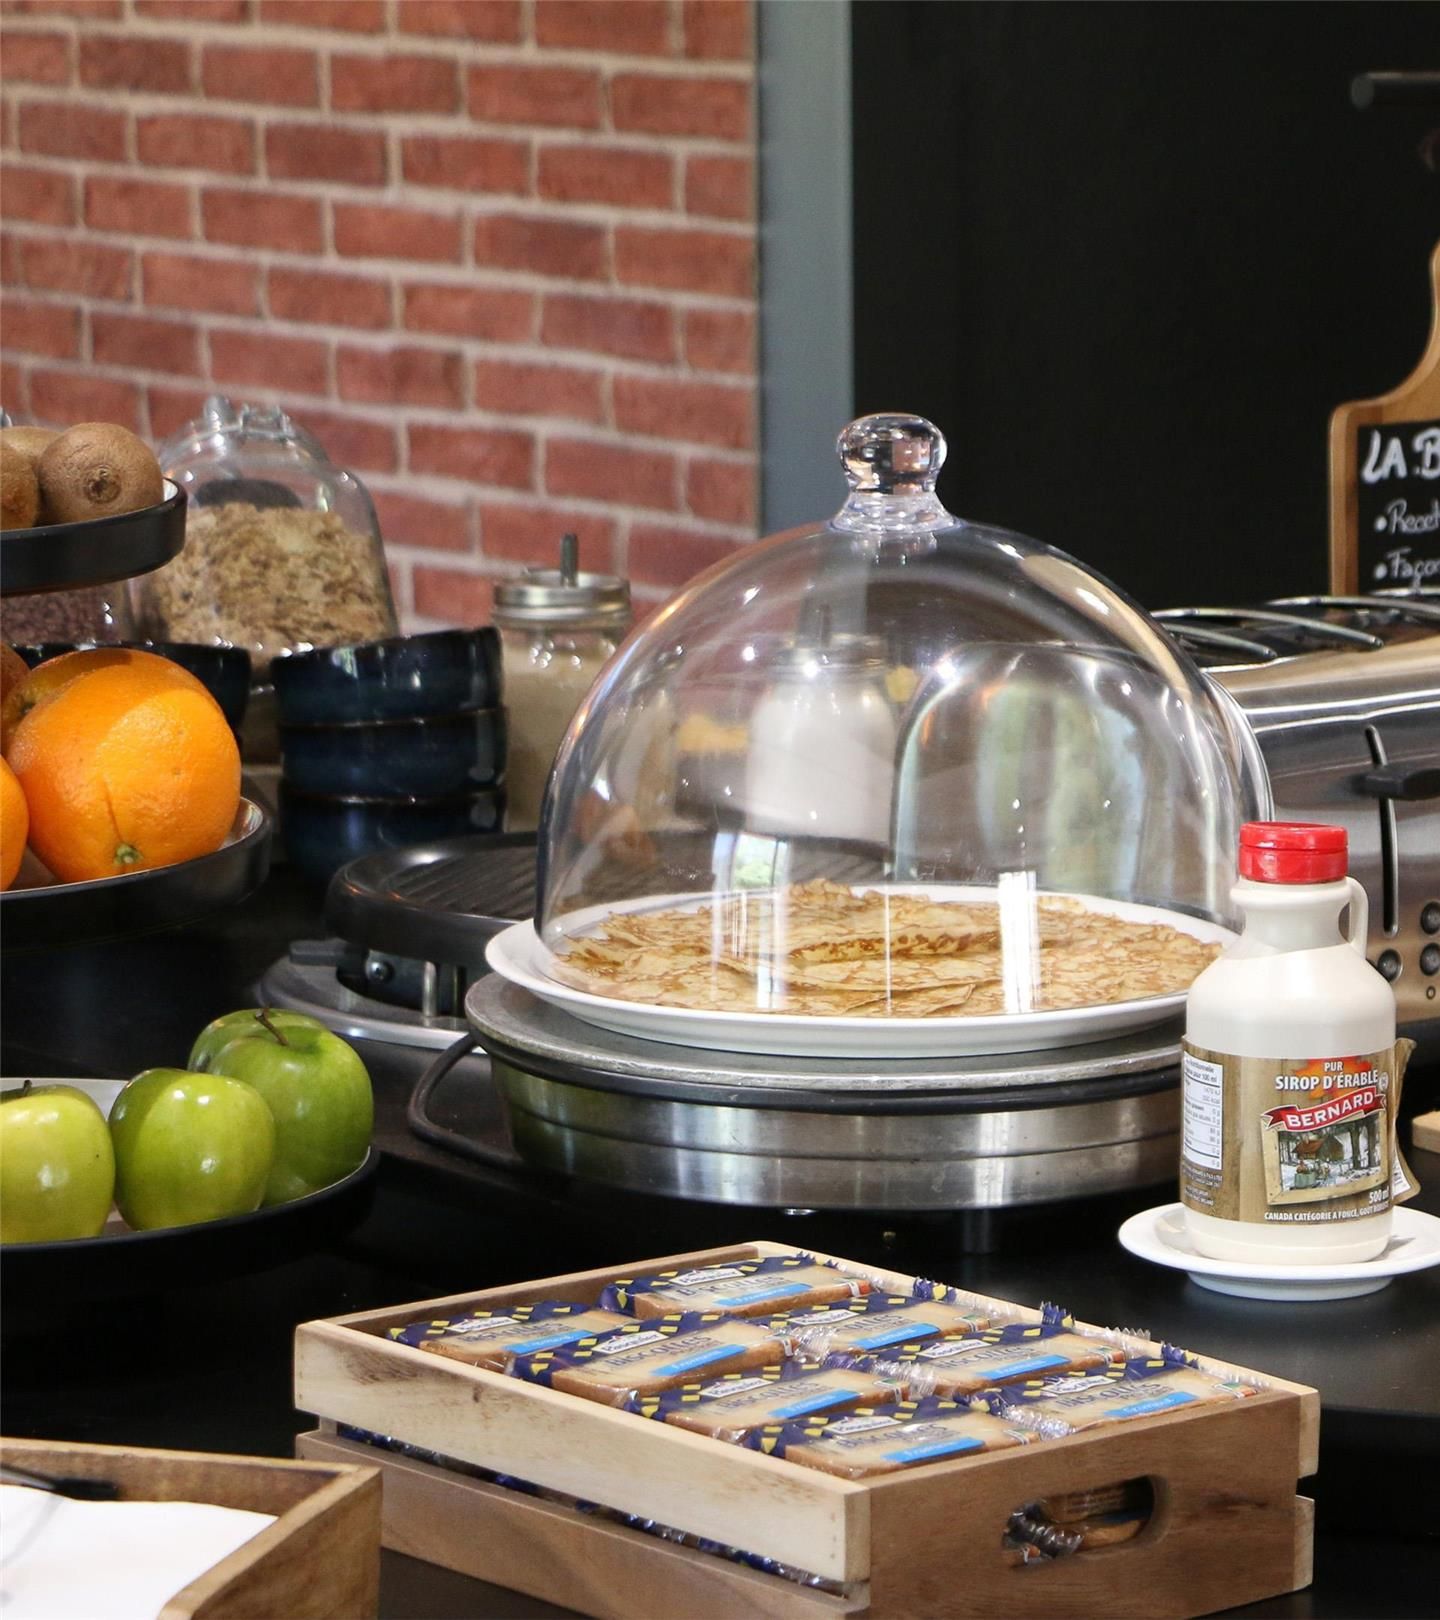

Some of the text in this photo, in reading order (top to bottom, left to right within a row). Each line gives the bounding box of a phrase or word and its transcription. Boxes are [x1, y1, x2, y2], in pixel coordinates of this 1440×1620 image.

[1361, 429, 1408, 484] LA
[1324, 1061, 1343, 1072] PUR
[1275, 1076, 1320, 1090] SIROP
[1323, 1069, 1379, 1090] D'ÉRABLE
[1285, 1091, 1374, 1127] BERNARD
[1368, 1189, 1382, 1204] 500
[1264, 1212, 1293, 1221] CANADA
[1294, 1210, 1331, 1221] CATÉGORIE
[604, 1336, 712, 1367] Biscottes
[836, 1423, 948, 1449] Biscoes
